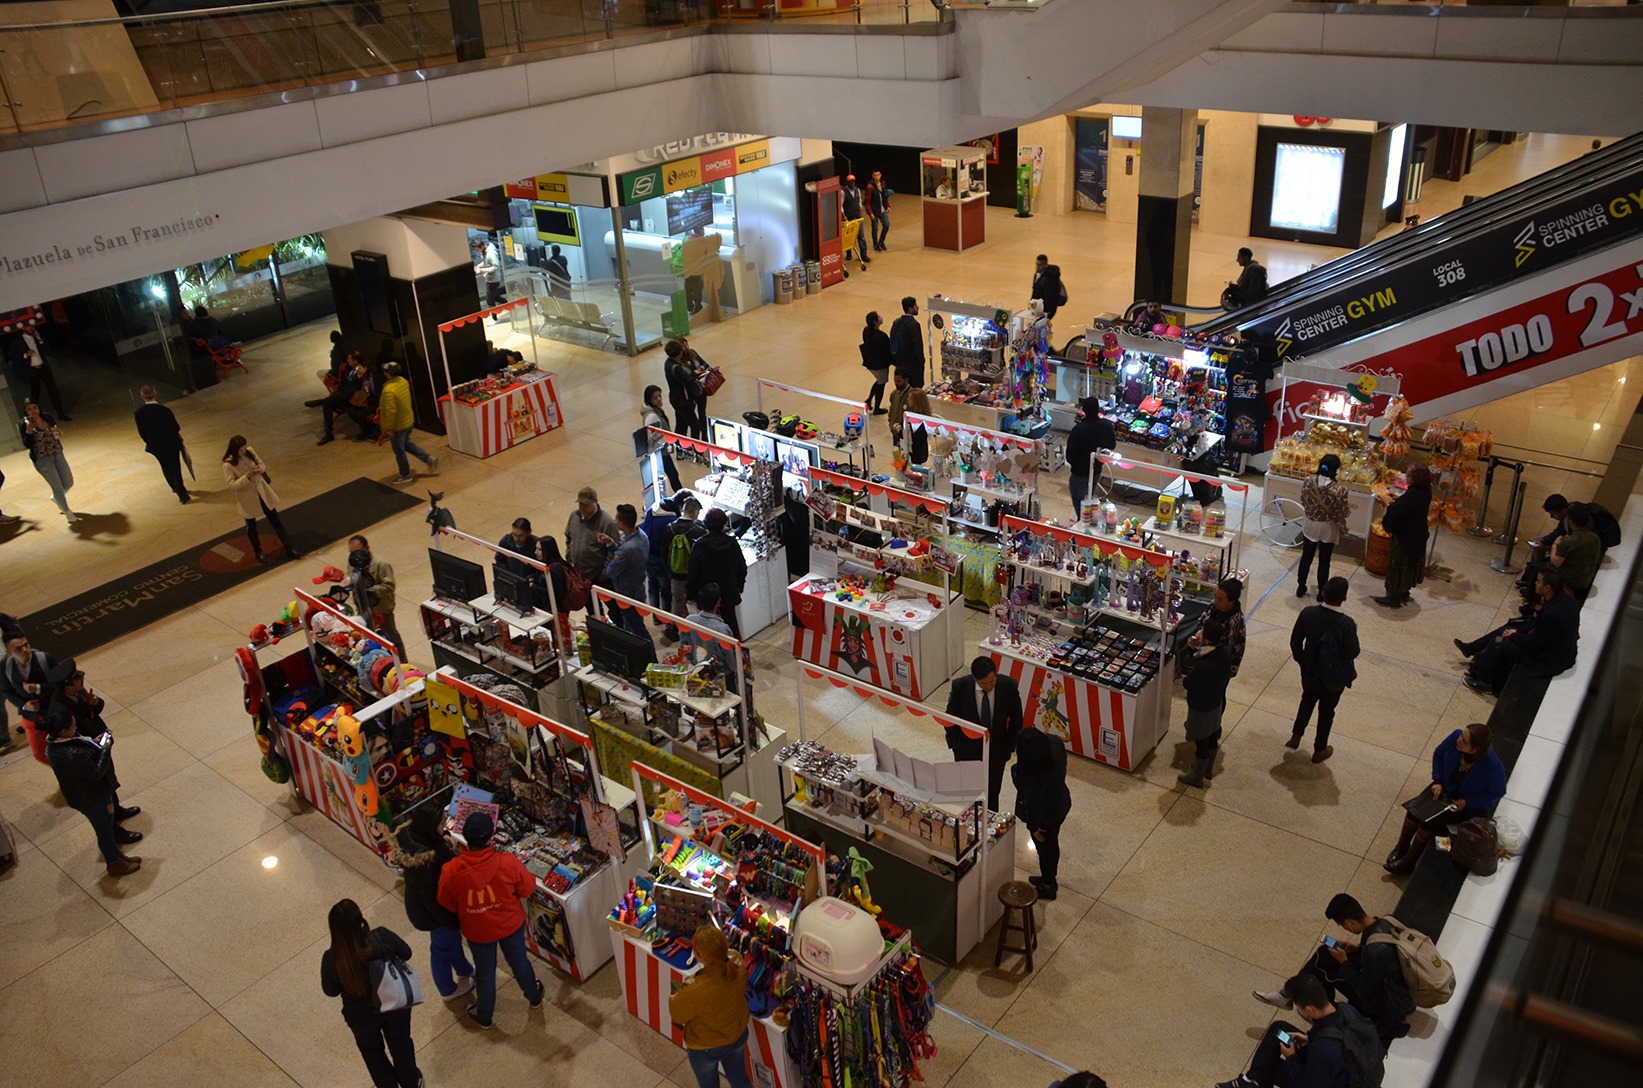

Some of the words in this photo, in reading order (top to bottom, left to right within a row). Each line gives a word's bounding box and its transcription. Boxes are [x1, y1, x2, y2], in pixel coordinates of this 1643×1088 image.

[677, 168, 697, 180] efecty
[93, 235, 128, 252] San
[131, 214, 213, 243] Francisco
[1538, 203, 1605, 236] SPINNING
[1543, 214, 1609, 247] CENTER
[1432, 259, 1463, 276] LOCAL
[1437, 267, 1467, 288] 308
[1293, 304, 1344, 331] SPINNING
[1297, 314, 1349, 341] CENTER
[1346, 287, 1397, 319] GYM
[1455, 313, 1554, 377] TODO
[133, 564, 189, 591] CENTRO
[44, 591, 129, 627] COMERCIAL
